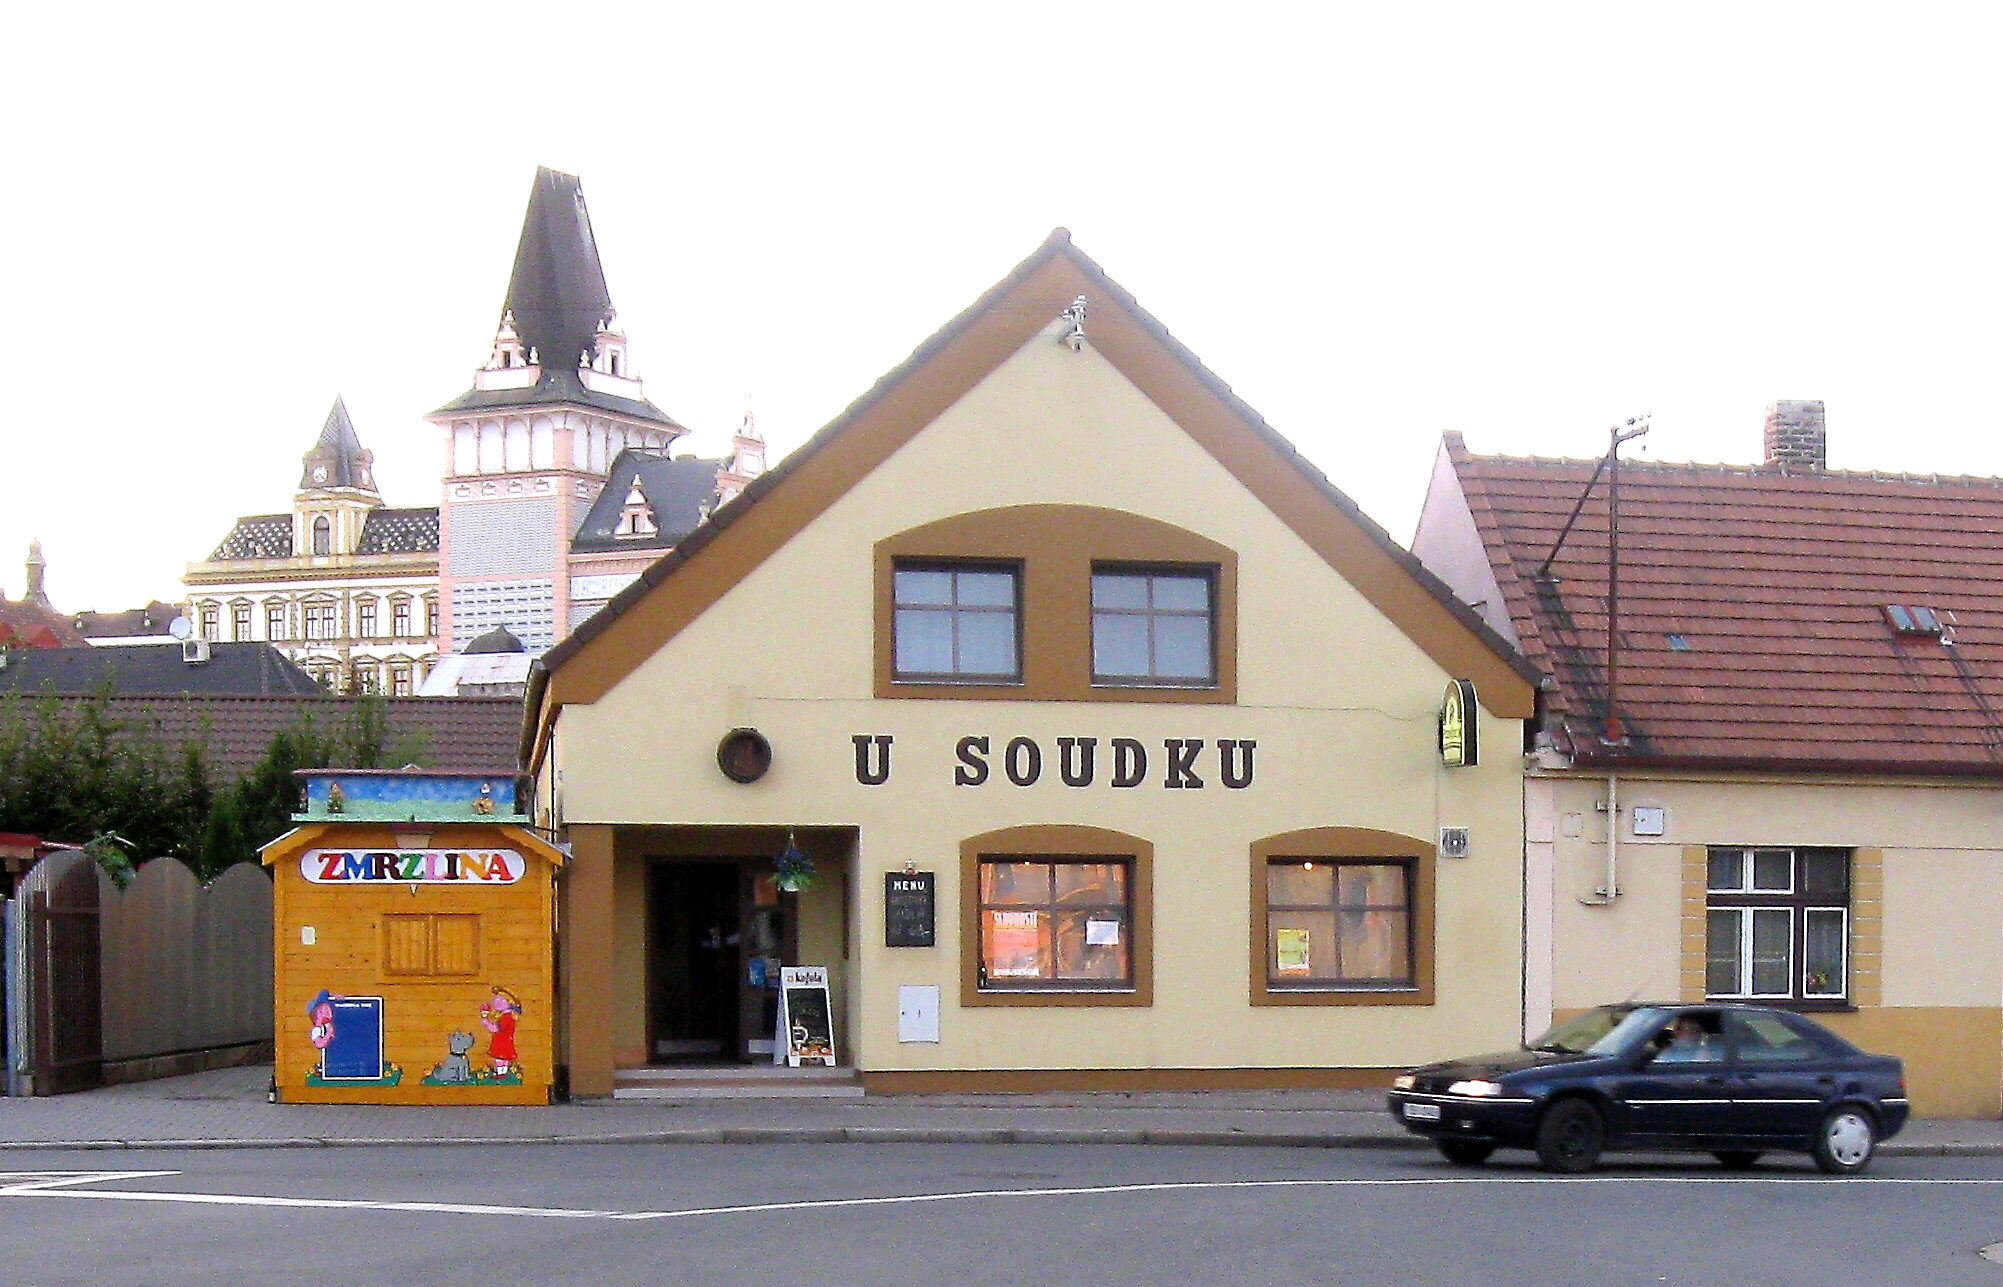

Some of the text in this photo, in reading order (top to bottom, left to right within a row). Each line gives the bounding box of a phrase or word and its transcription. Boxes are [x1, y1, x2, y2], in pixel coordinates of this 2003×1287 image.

[851, 735, 1257, 789] U SOUDKU
[317, 852, 515, 880] ZMRZLINA
[893, 880, 925, 891] MENU
